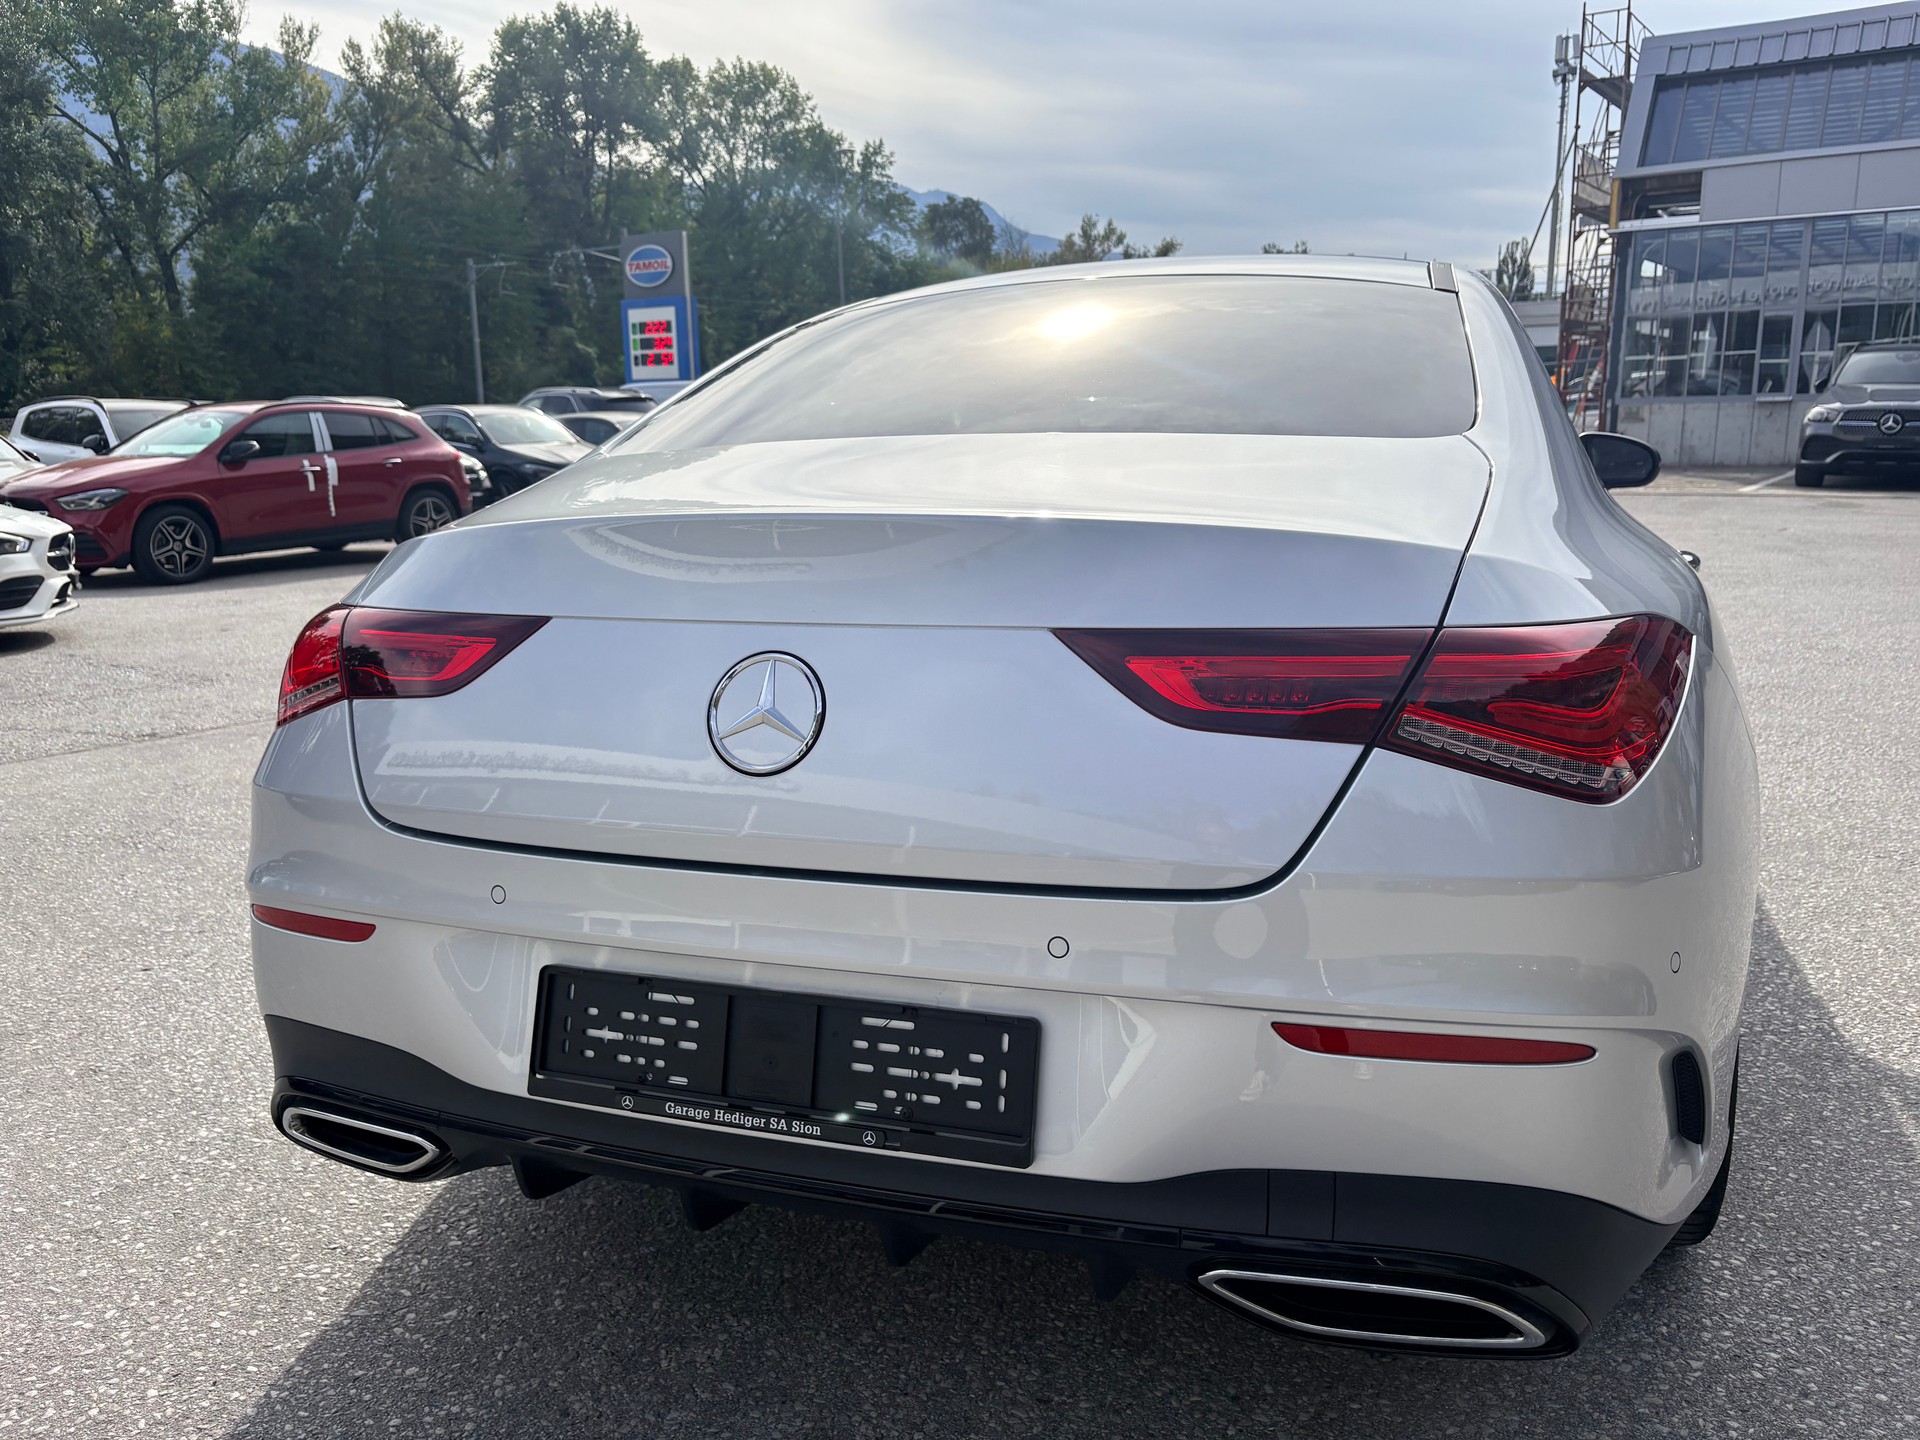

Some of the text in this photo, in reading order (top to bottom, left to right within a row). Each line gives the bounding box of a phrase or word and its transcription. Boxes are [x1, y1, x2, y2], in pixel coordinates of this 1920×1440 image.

[628, 261, 670, 273] TAMOIL
[665, 1102, 821, 1135] Garage Hediger SA Sion
